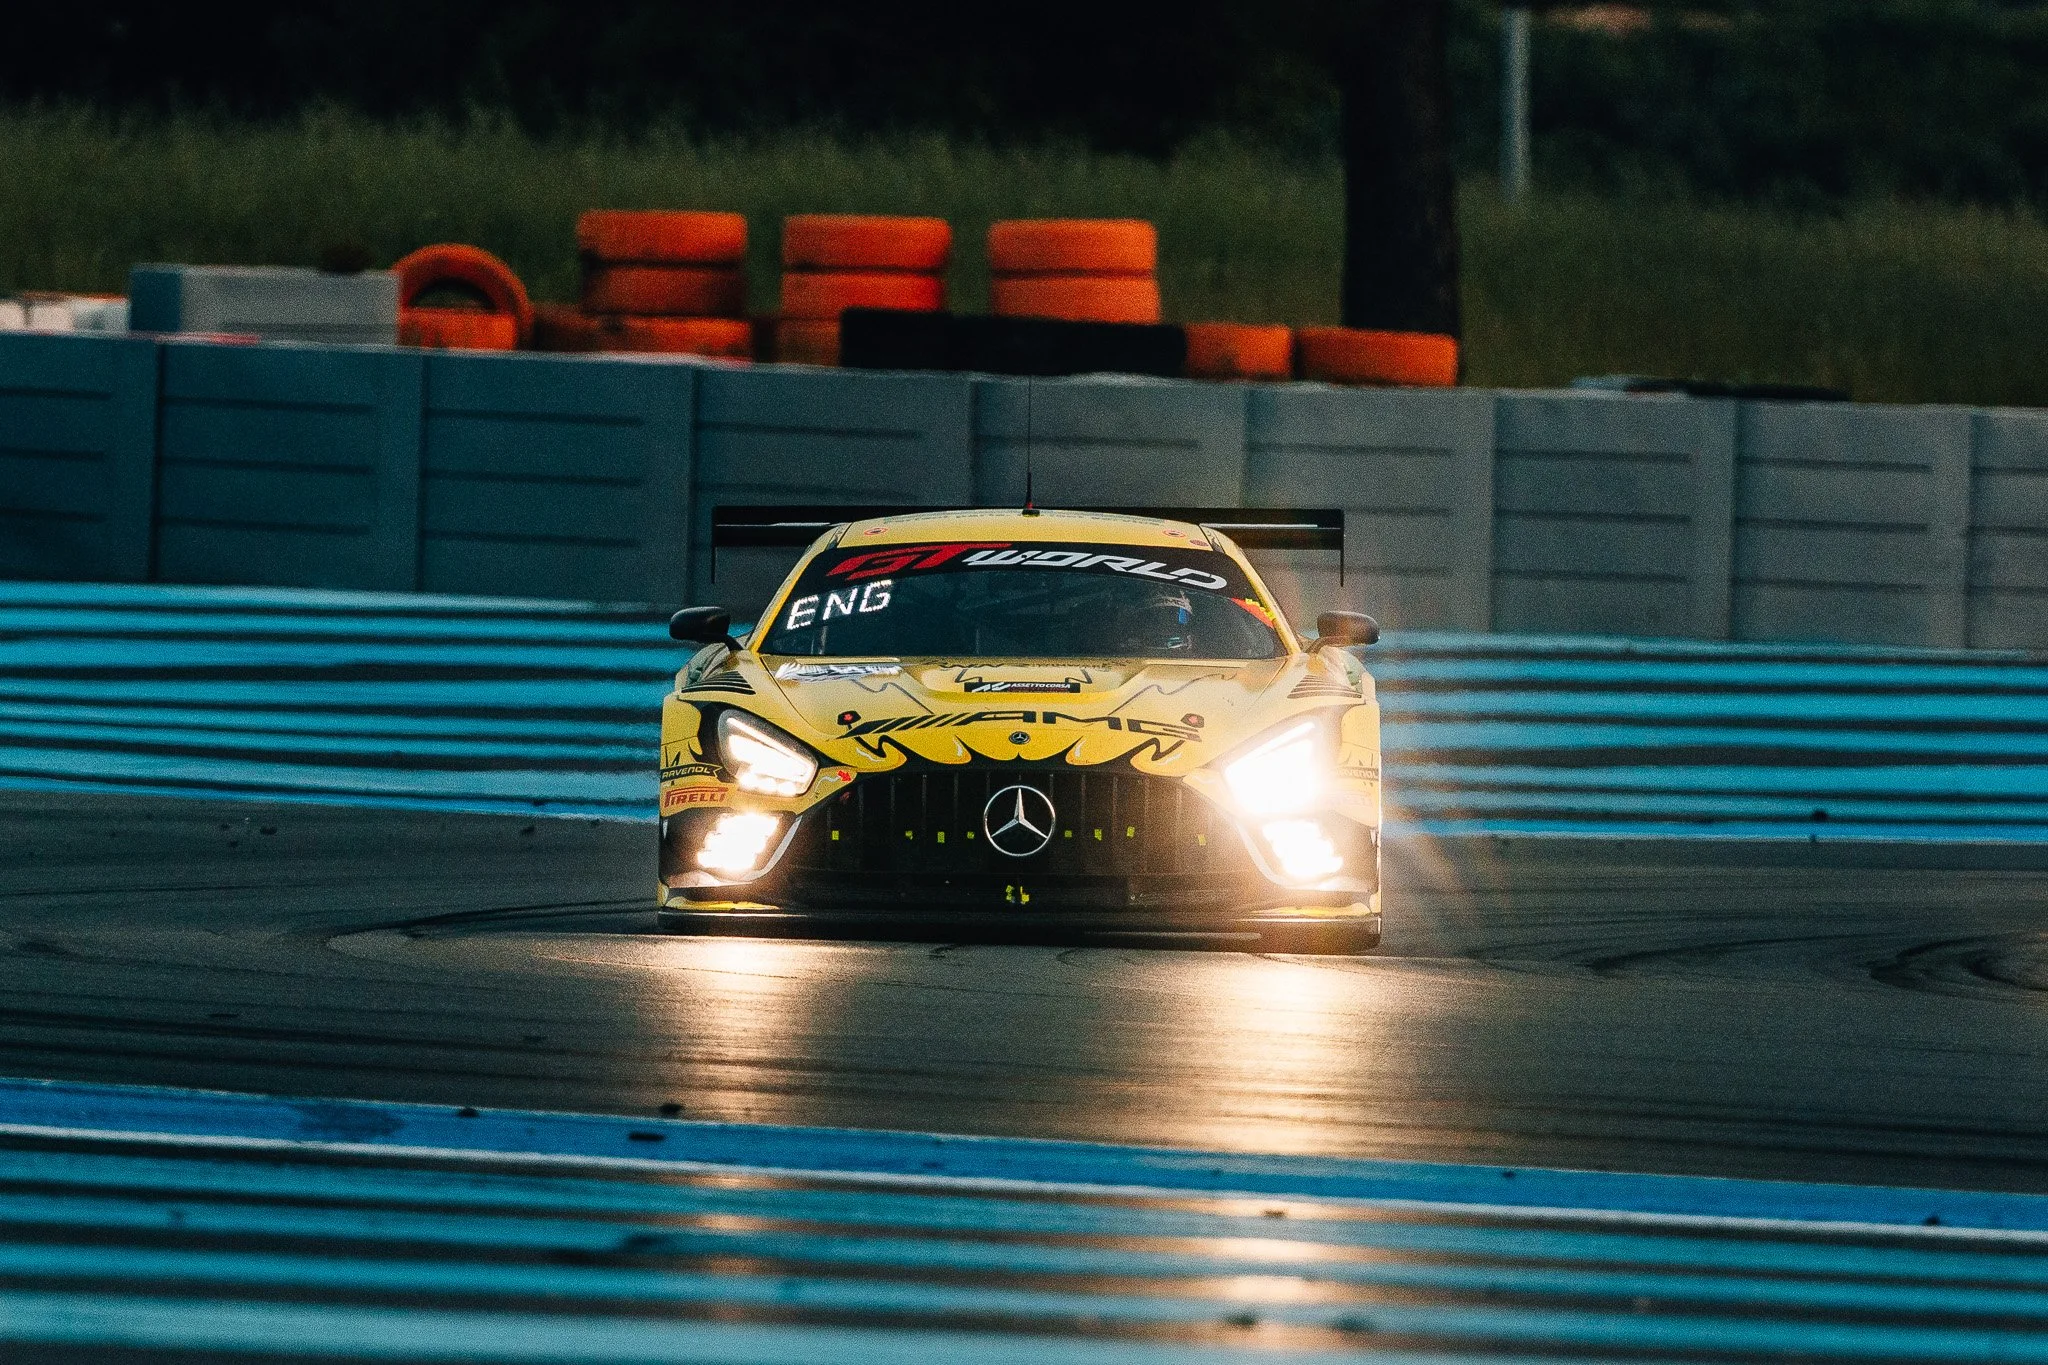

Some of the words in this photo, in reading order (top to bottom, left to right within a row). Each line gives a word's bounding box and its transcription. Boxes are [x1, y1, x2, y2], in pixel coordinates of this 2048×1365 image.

[826, 542, 1011, 580] GT
[962, 549, 1228, 590] WORLD
[785, 579, 893, 631] ENG
[950, 711, 1203, 742] AMG
[662, 766, 711, 779] RAVENOL
[664, 786, 728, 808] PIRELLI
